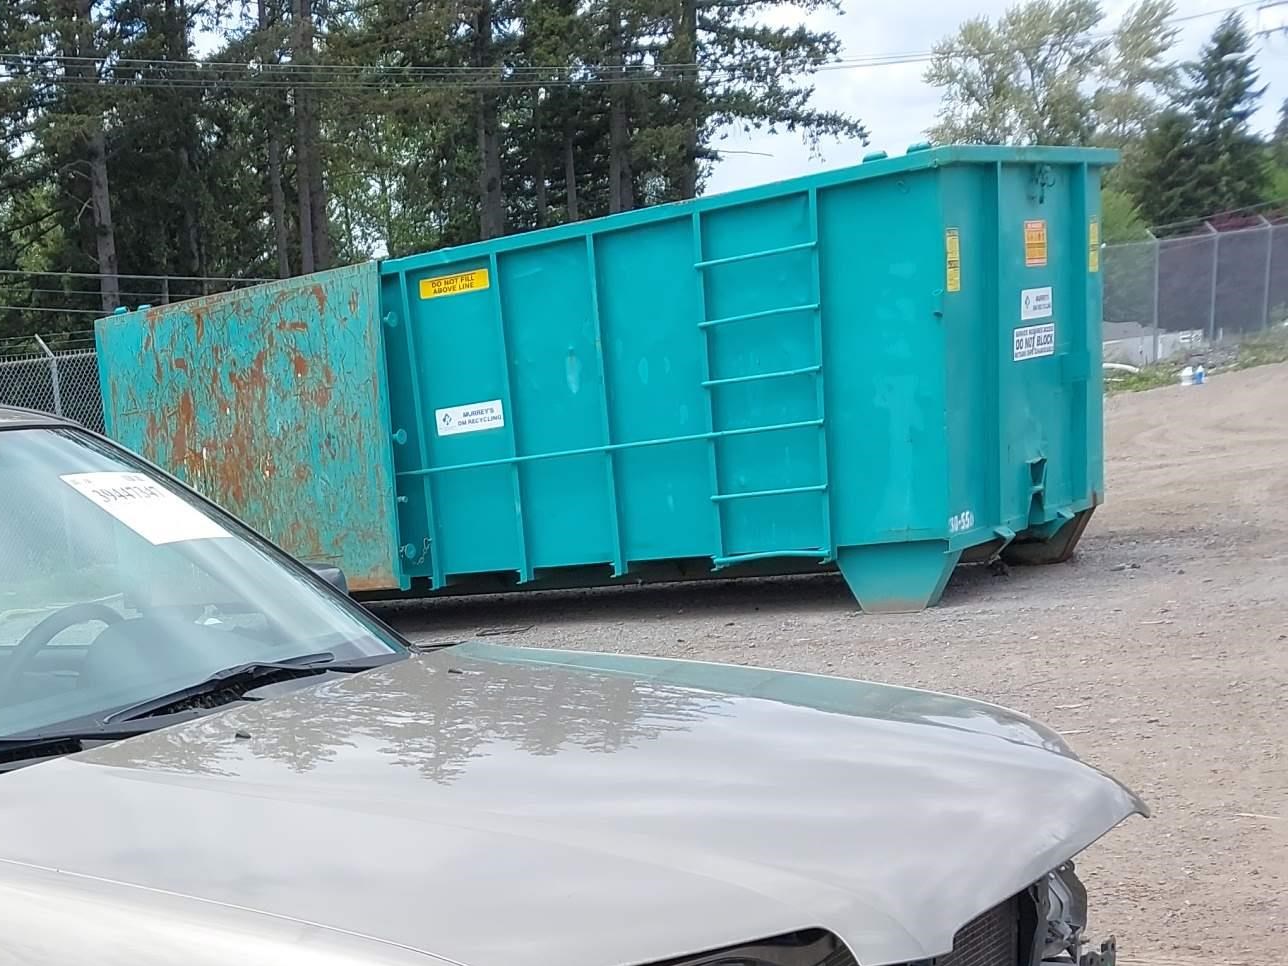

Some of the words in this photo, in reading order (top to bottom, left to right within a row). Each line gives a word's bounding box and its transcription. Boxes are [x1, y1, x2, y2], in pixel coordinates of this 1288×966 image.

[443, 278, 458, 286] NOT
[460, 275, 475, 283] FILL
[433, 285, 457, 295] ABOVE
[459, 281, 475, 290] LINE
